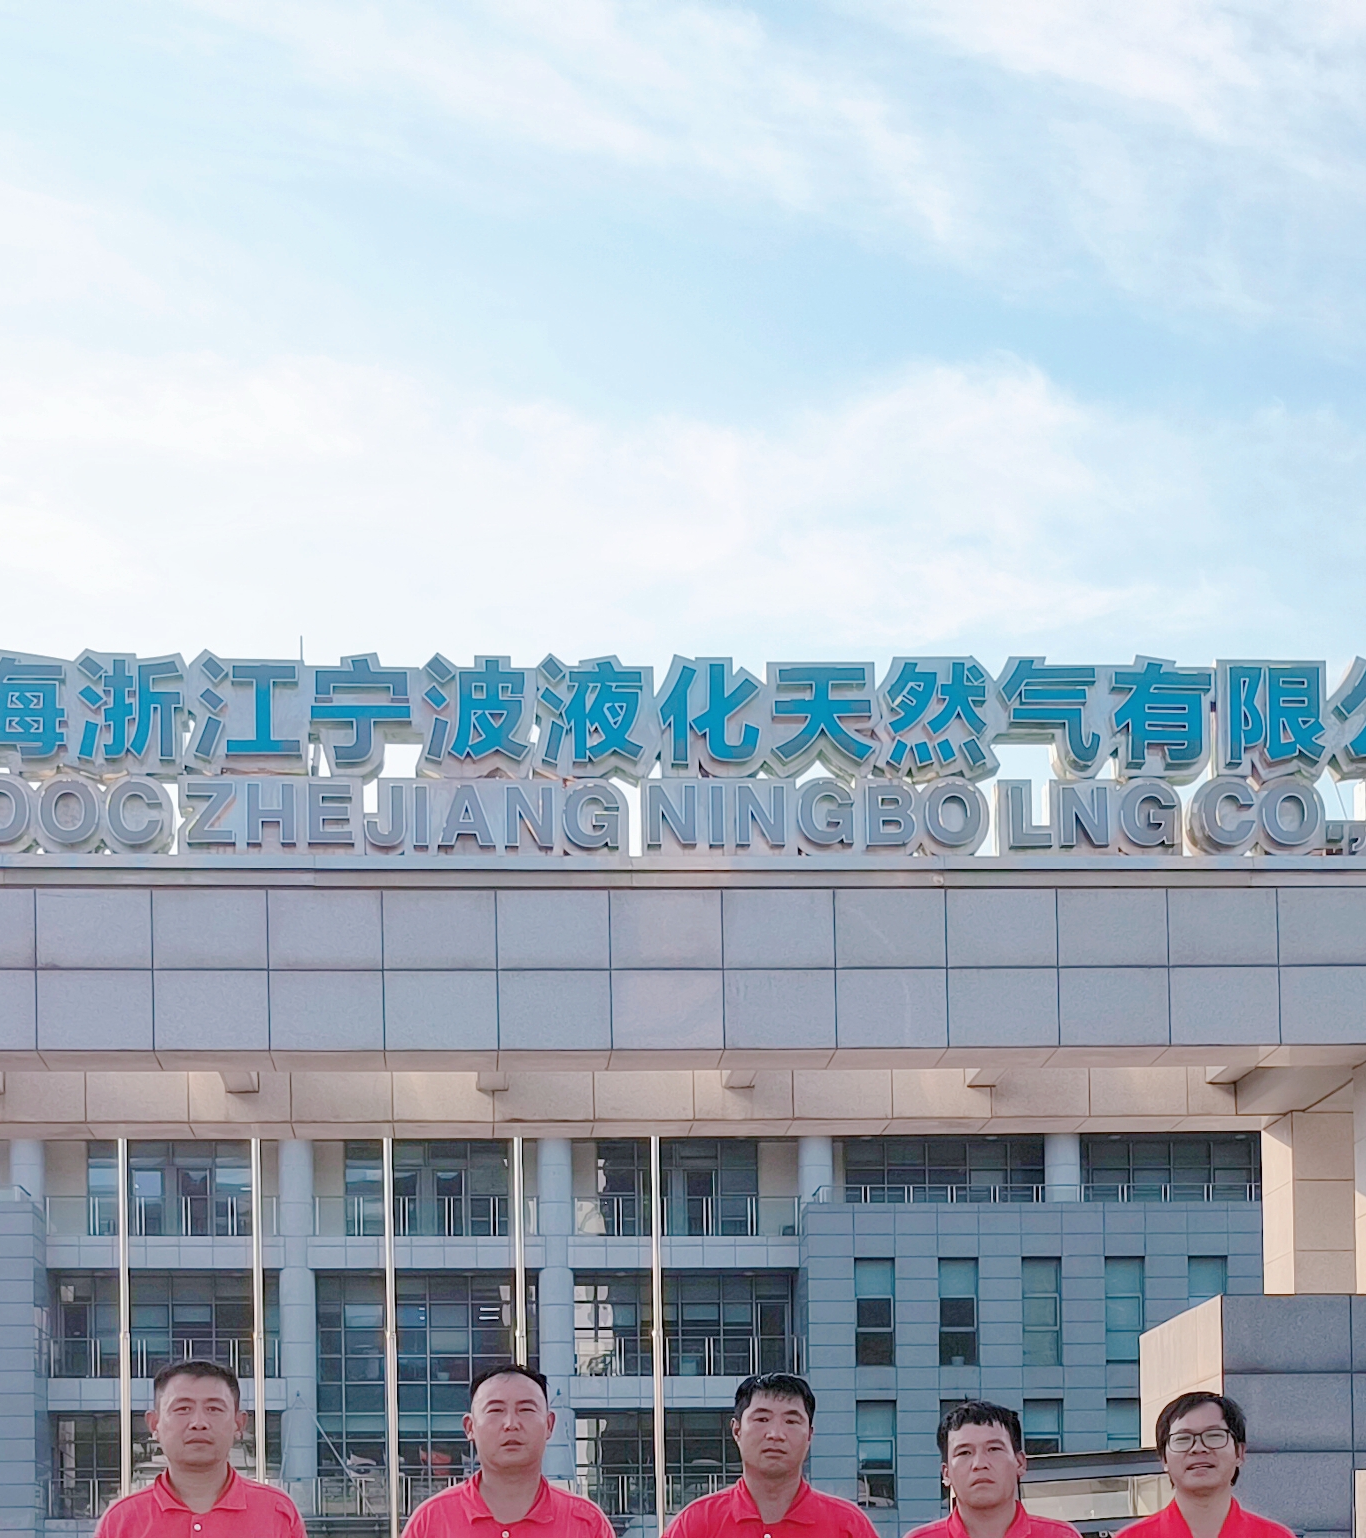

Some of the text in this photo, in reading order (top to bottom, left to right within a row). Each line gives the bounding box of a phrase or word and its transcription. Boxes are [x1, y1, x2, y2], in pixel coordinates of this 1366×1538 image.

[186, 780, 621, 848] ZHEJIANG
[646, 780, 982, 848] NINGBO
[1007, 784, 1180, 850] LNG
